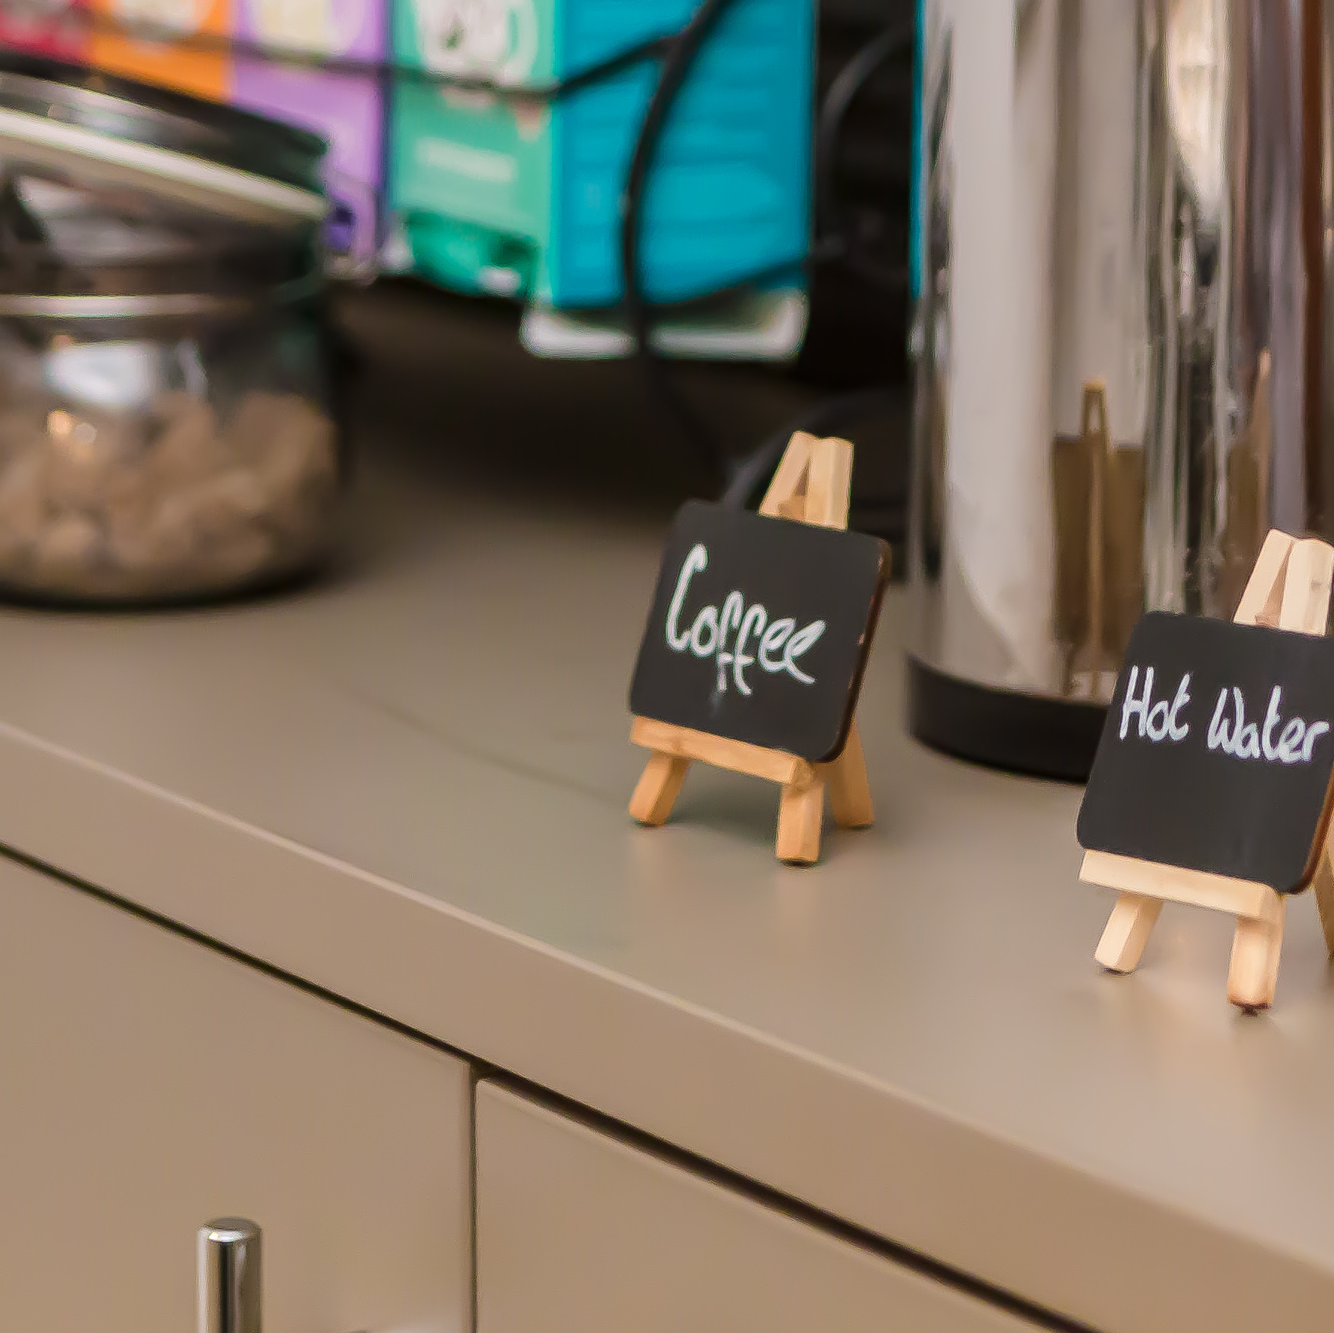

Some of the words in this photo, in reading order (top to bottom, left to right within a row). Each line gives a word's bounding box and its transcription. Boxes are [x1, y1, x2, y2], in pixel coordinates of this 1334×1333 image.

[666, 542, 827, 695] Coffee
[1119, 664, 1192, 742] Hot
[1207, 684, 1330, 764] Water
